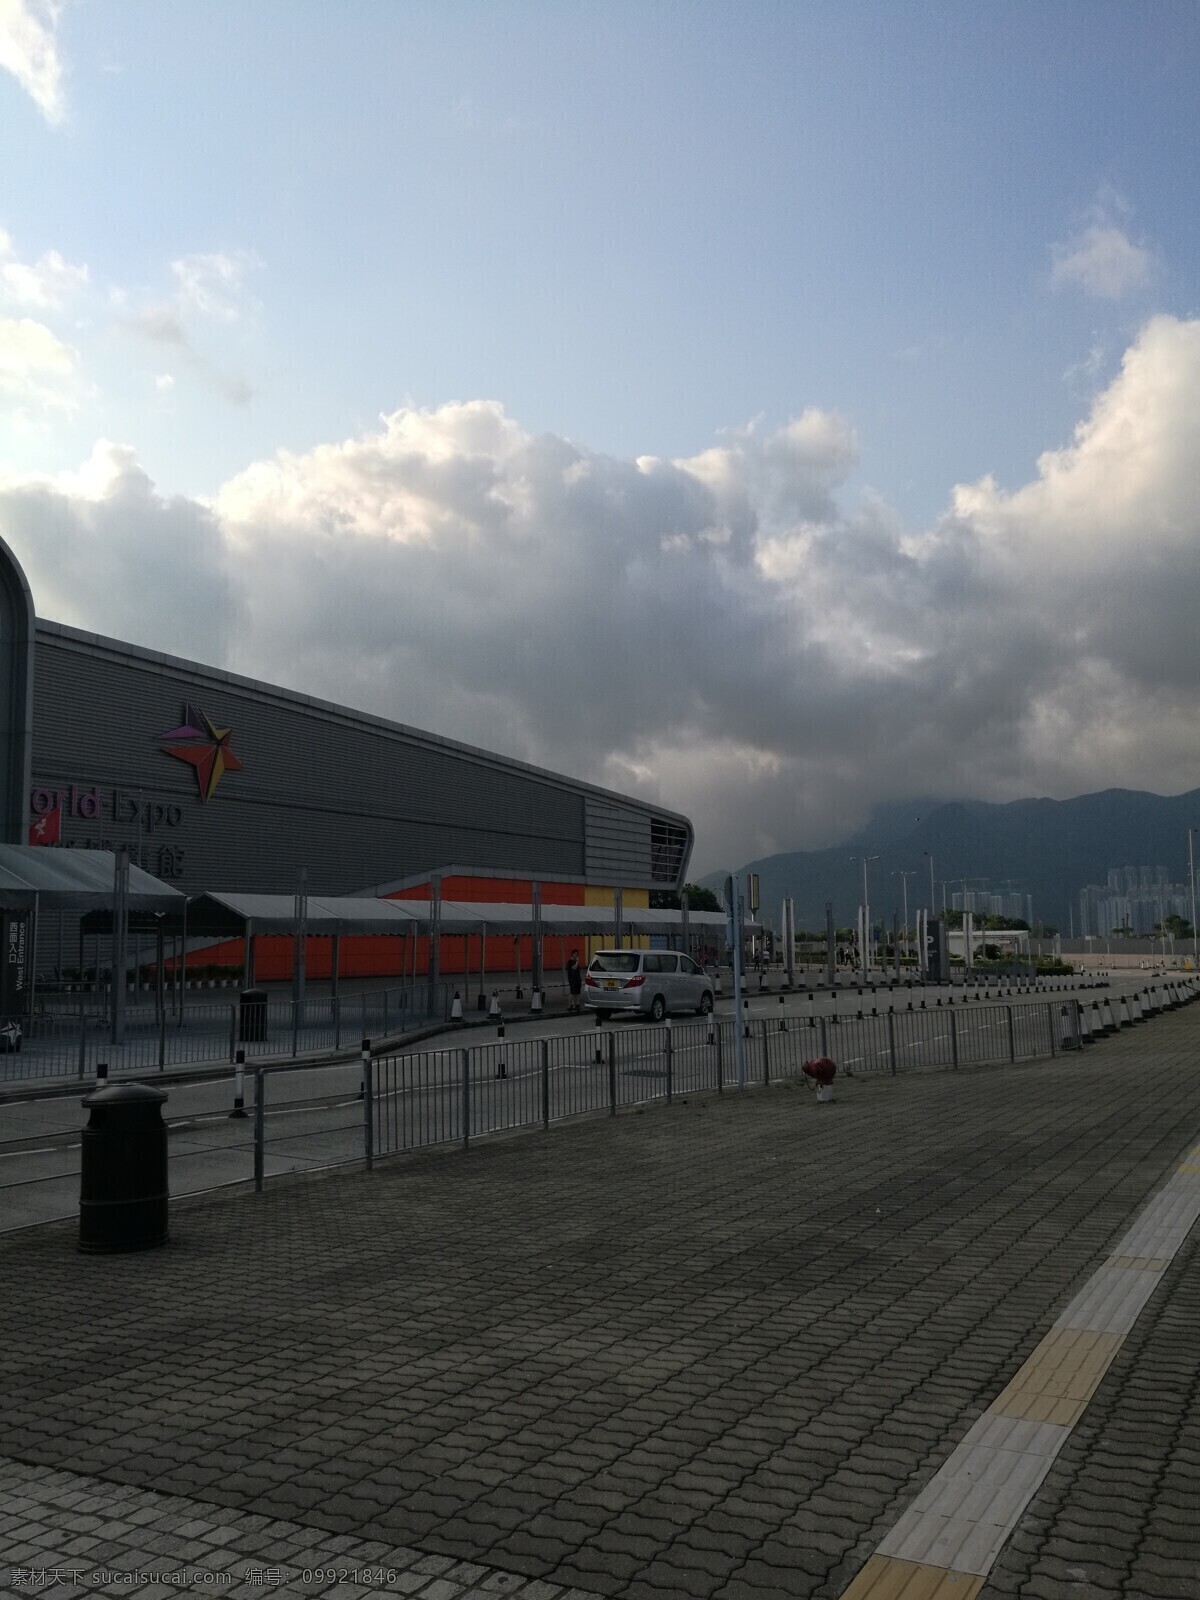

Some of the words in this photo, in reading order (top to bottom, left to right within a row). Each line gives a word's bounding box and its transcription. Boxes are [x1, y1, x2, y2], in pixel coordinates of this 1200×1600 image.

[8, 921, 18, 964] 西面入口
[17, 922, 26, 964] Entrance
[16, 966, 24, 991] West
